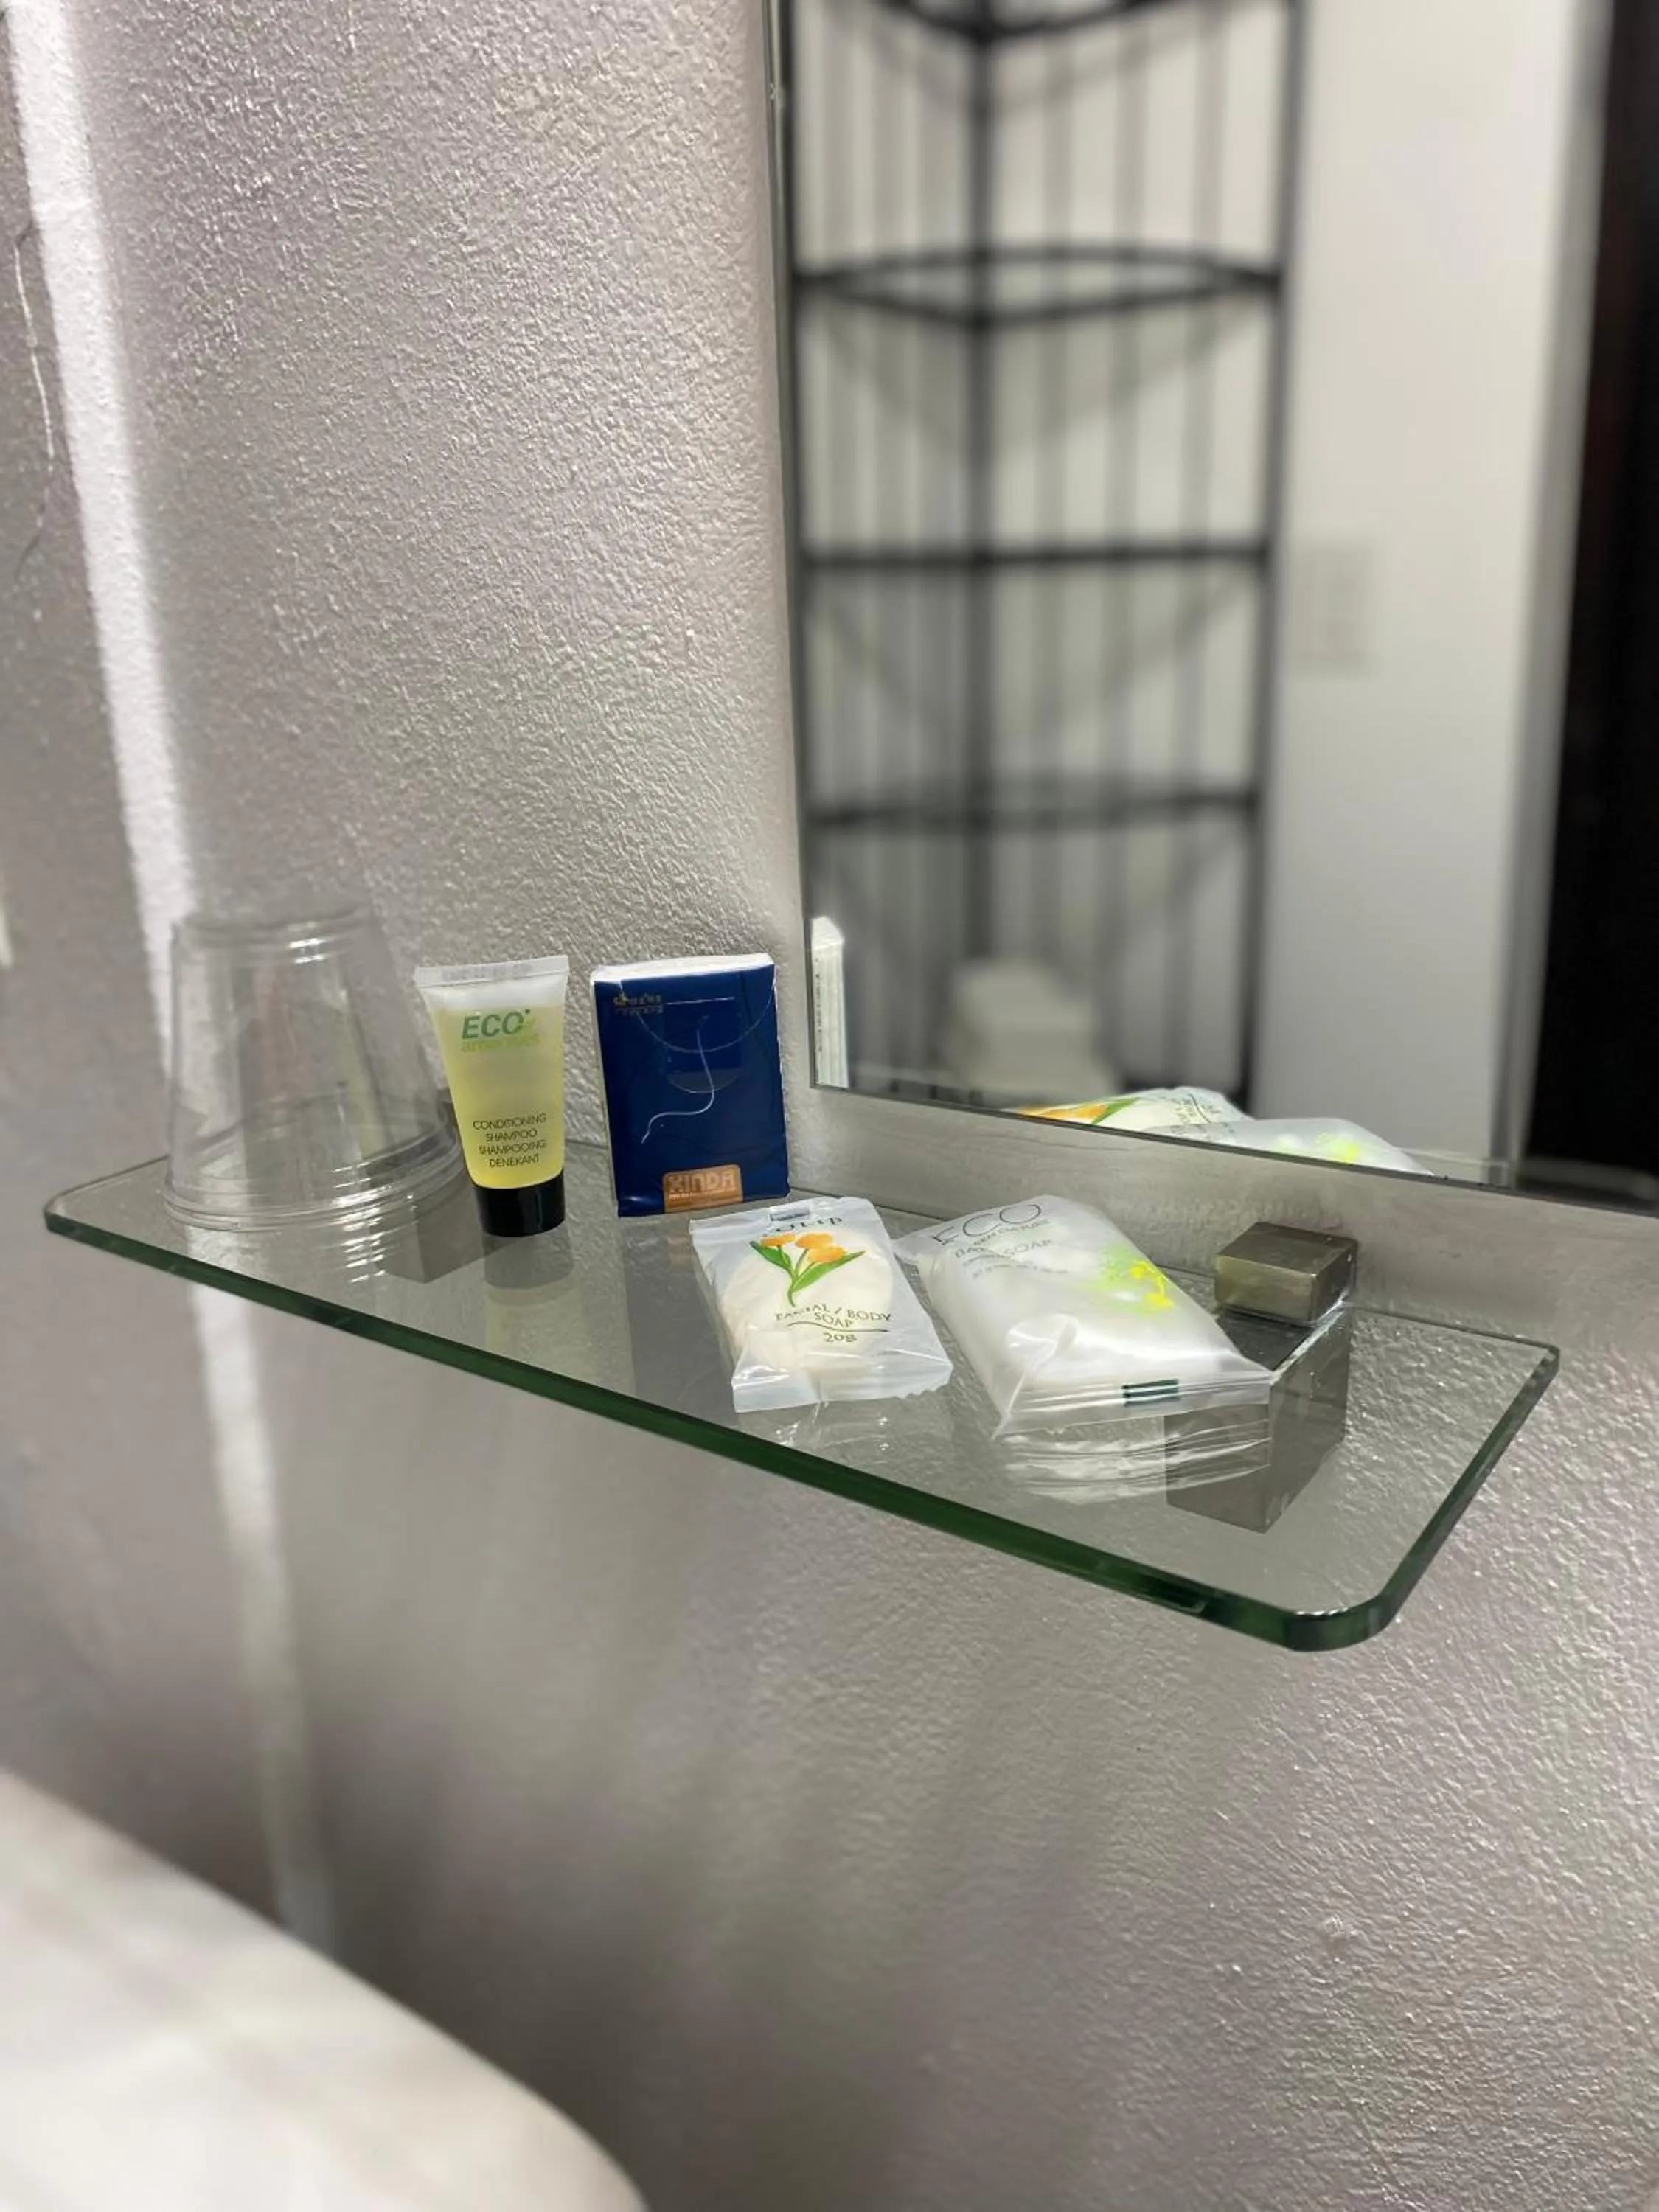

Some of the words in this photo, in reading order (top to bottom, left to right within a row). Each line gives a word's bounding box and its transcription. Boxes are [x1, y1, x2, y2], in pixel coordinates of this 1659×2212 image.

[484, 1127, 538, 1142] SHAMPOO
[813, 1312, 853, 1328] SOAP
[847, 1309, 891, 1321] BODY
